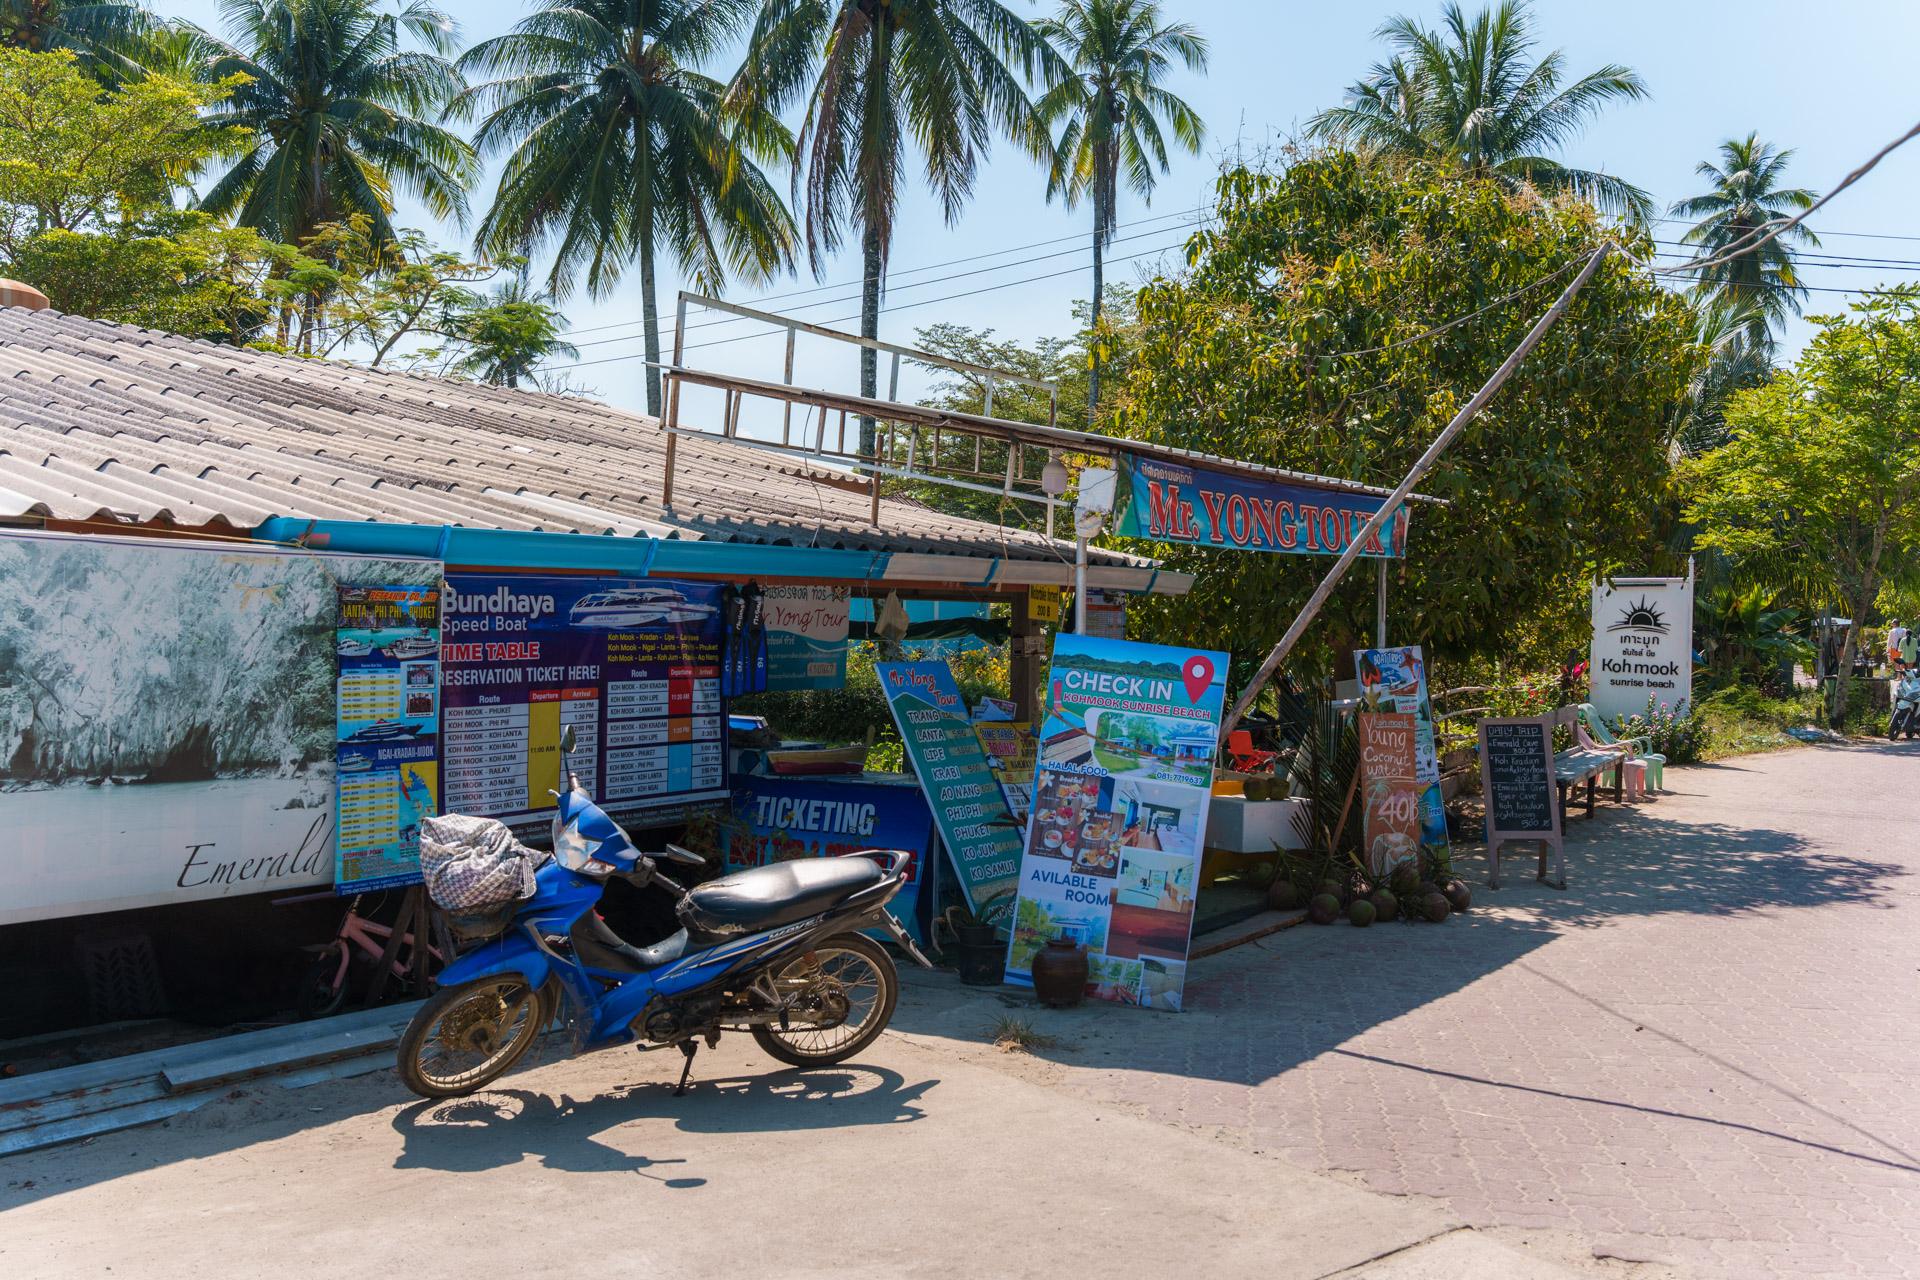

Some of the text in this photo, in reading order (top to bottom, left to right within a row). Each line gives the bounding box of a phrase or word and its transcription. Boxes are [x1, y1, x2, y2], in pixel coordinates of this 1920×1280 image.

[1147, 480, 1385, 555] Mr. YONG TOUR
[442, 586, 555, 618] Bundhaya
[343, 604, 367, 618] LANTA
[375, 605, 387, 618] PHI
[409, 606, 436, 619] PHUKET
[814, 608, 847, 627] Tour
[1046, 605, 1051, 617] B
[442, 616, 528, 636] Speed Boat
[608, 633, 619, 641] Koh
[1620, 635, 1660, 648] เกาะมุก
[441, 641, 540, 662] TIME TABLE
[608, 655, 619, 663] Koh
[631, 669, 648, 678] Route
[1602, 658, 1679, 676] Koh mook
[440, 665, 600, 686] RESERVATION TICKET HERE!
[1064, 670, 1173, 700] CHECK IN
[1610, 679, 1675, 689] sunrise beach
[479, 690, 591, 704] Route Departure Arrival
[934, 690, 958, 705] Tour
[448, 709, 464, 717] KOH
[464, 707, 484, 716] MOOK
[1063, 693, 1211, 720] KOHMOOK SUNRISE BEACH
[907, 710, 939, 723] TRANG
[448, 720, 484, 730] KOH MOOK
[1488, 726, 1539, 736] DAILY TRIP
[448, 734, 463, 742] KOH
[464, 733, 484, 741] MOOK
[503, 730, 523, 738] LANTA
[915, 729, 946, 743] LANTA
[1362, 717, 1408, 753] Young
[448, 746, 463, 754] KOH
[463, 745, 484, 753] MOOK
[924, 748, 945, 762] LIPE
[1363, 746, 1412, 767] Coconut
[448, 758, 463, 766] KOH
[463, 756, 484, 765] MOOK
[448, 768, 484, 778] KOH MOOK
[932, 766, 960, 781] KRABI
[1048, 761, 1108, 777] HALAL FOOD
[1366, 763, 1406, 776] water
[448, 782, 463, 790] KOH
[463, 780, 484, 789] MOOK
[941, 784, 981, 801] AO NANG
[448, 794, 463, 803] KOH
[462, 793, 483, 801] MOOK
[462, 805, 483, 813] MOOK
[755, 795, 877, 836] TICKETING
[946, 803, 983, 822] PHI PHI
[1428, 807, 1441, 816] Free
[954, 823, 990, 841] PHUKET
[176, 812, 335, 888] Emerald
[962, 842, 997, 861] KO JUM
[970, 860, 1016, 881] KO SAMUI
[1031, 869, 1098, 891] AVILABLE
[1065, 889, 1109, 908] ROOM
